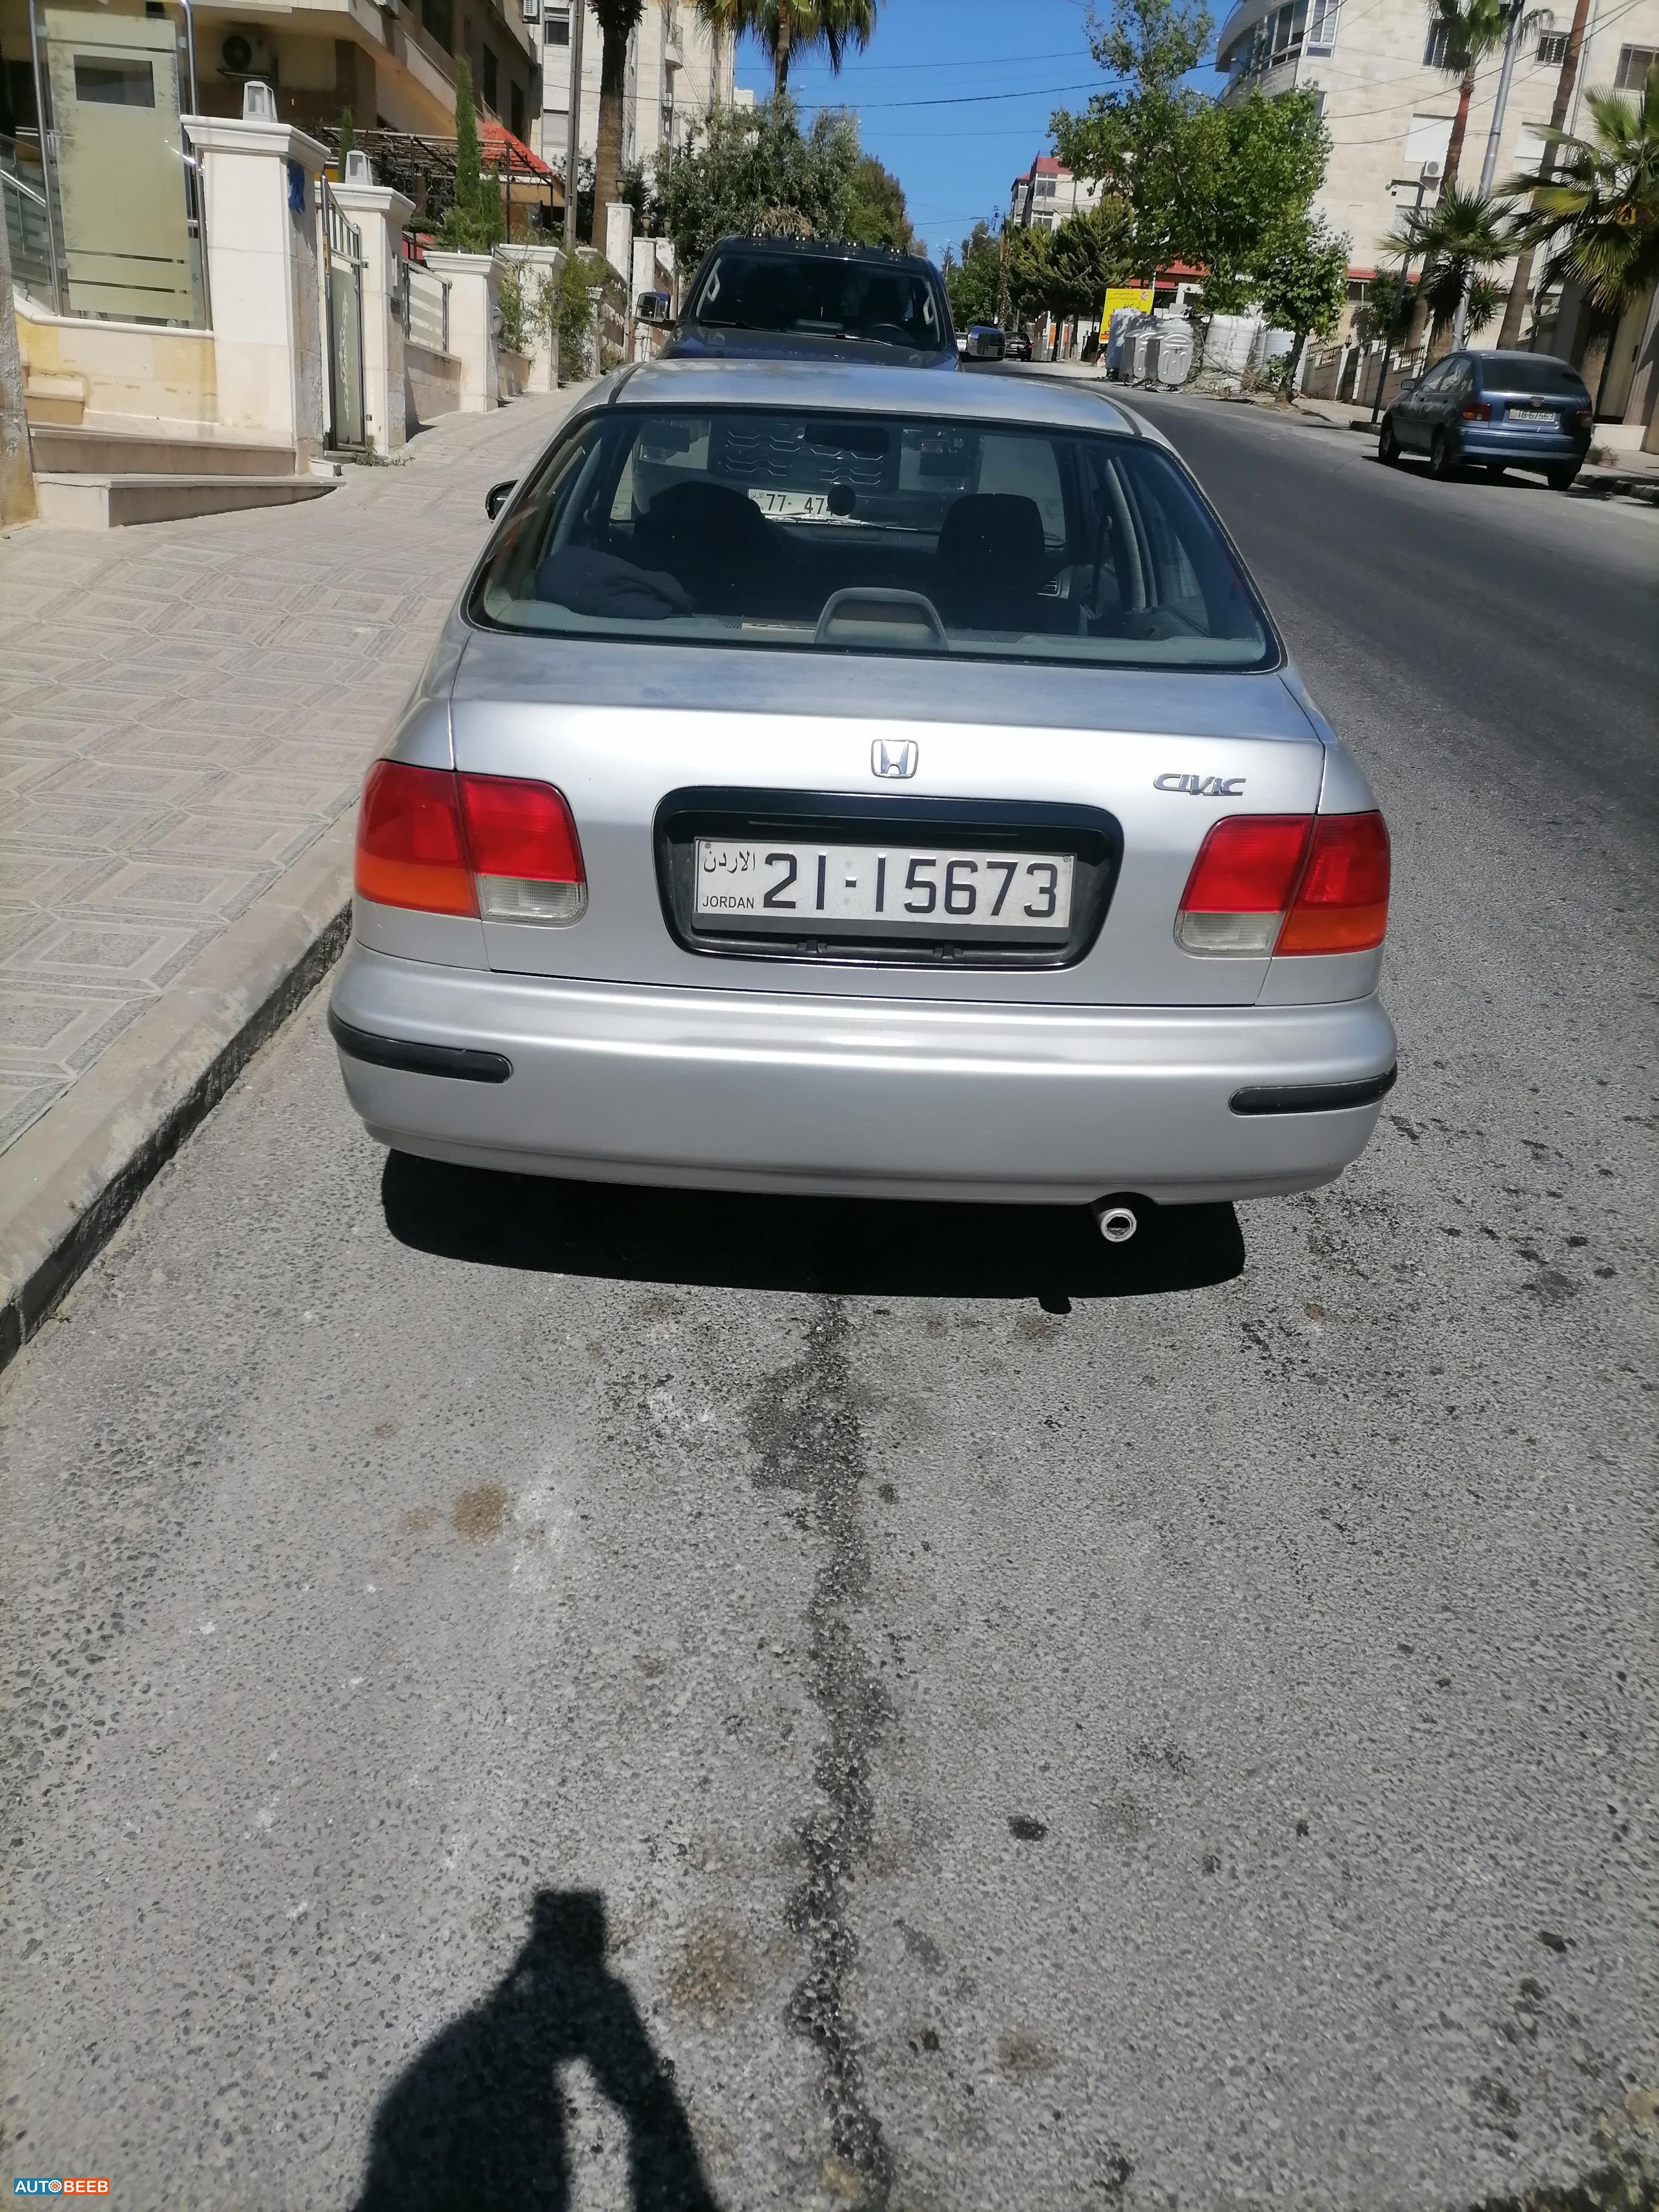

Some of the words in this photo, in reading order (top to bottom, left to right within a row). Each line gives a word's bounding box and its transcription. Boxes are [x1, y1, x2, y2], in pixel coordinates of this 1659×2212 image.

[1153, 773, 1246, 795] CIVIC
[763, 852, 1058, 918] 21-15673
[702, 895, 754, 909] JORDAN
